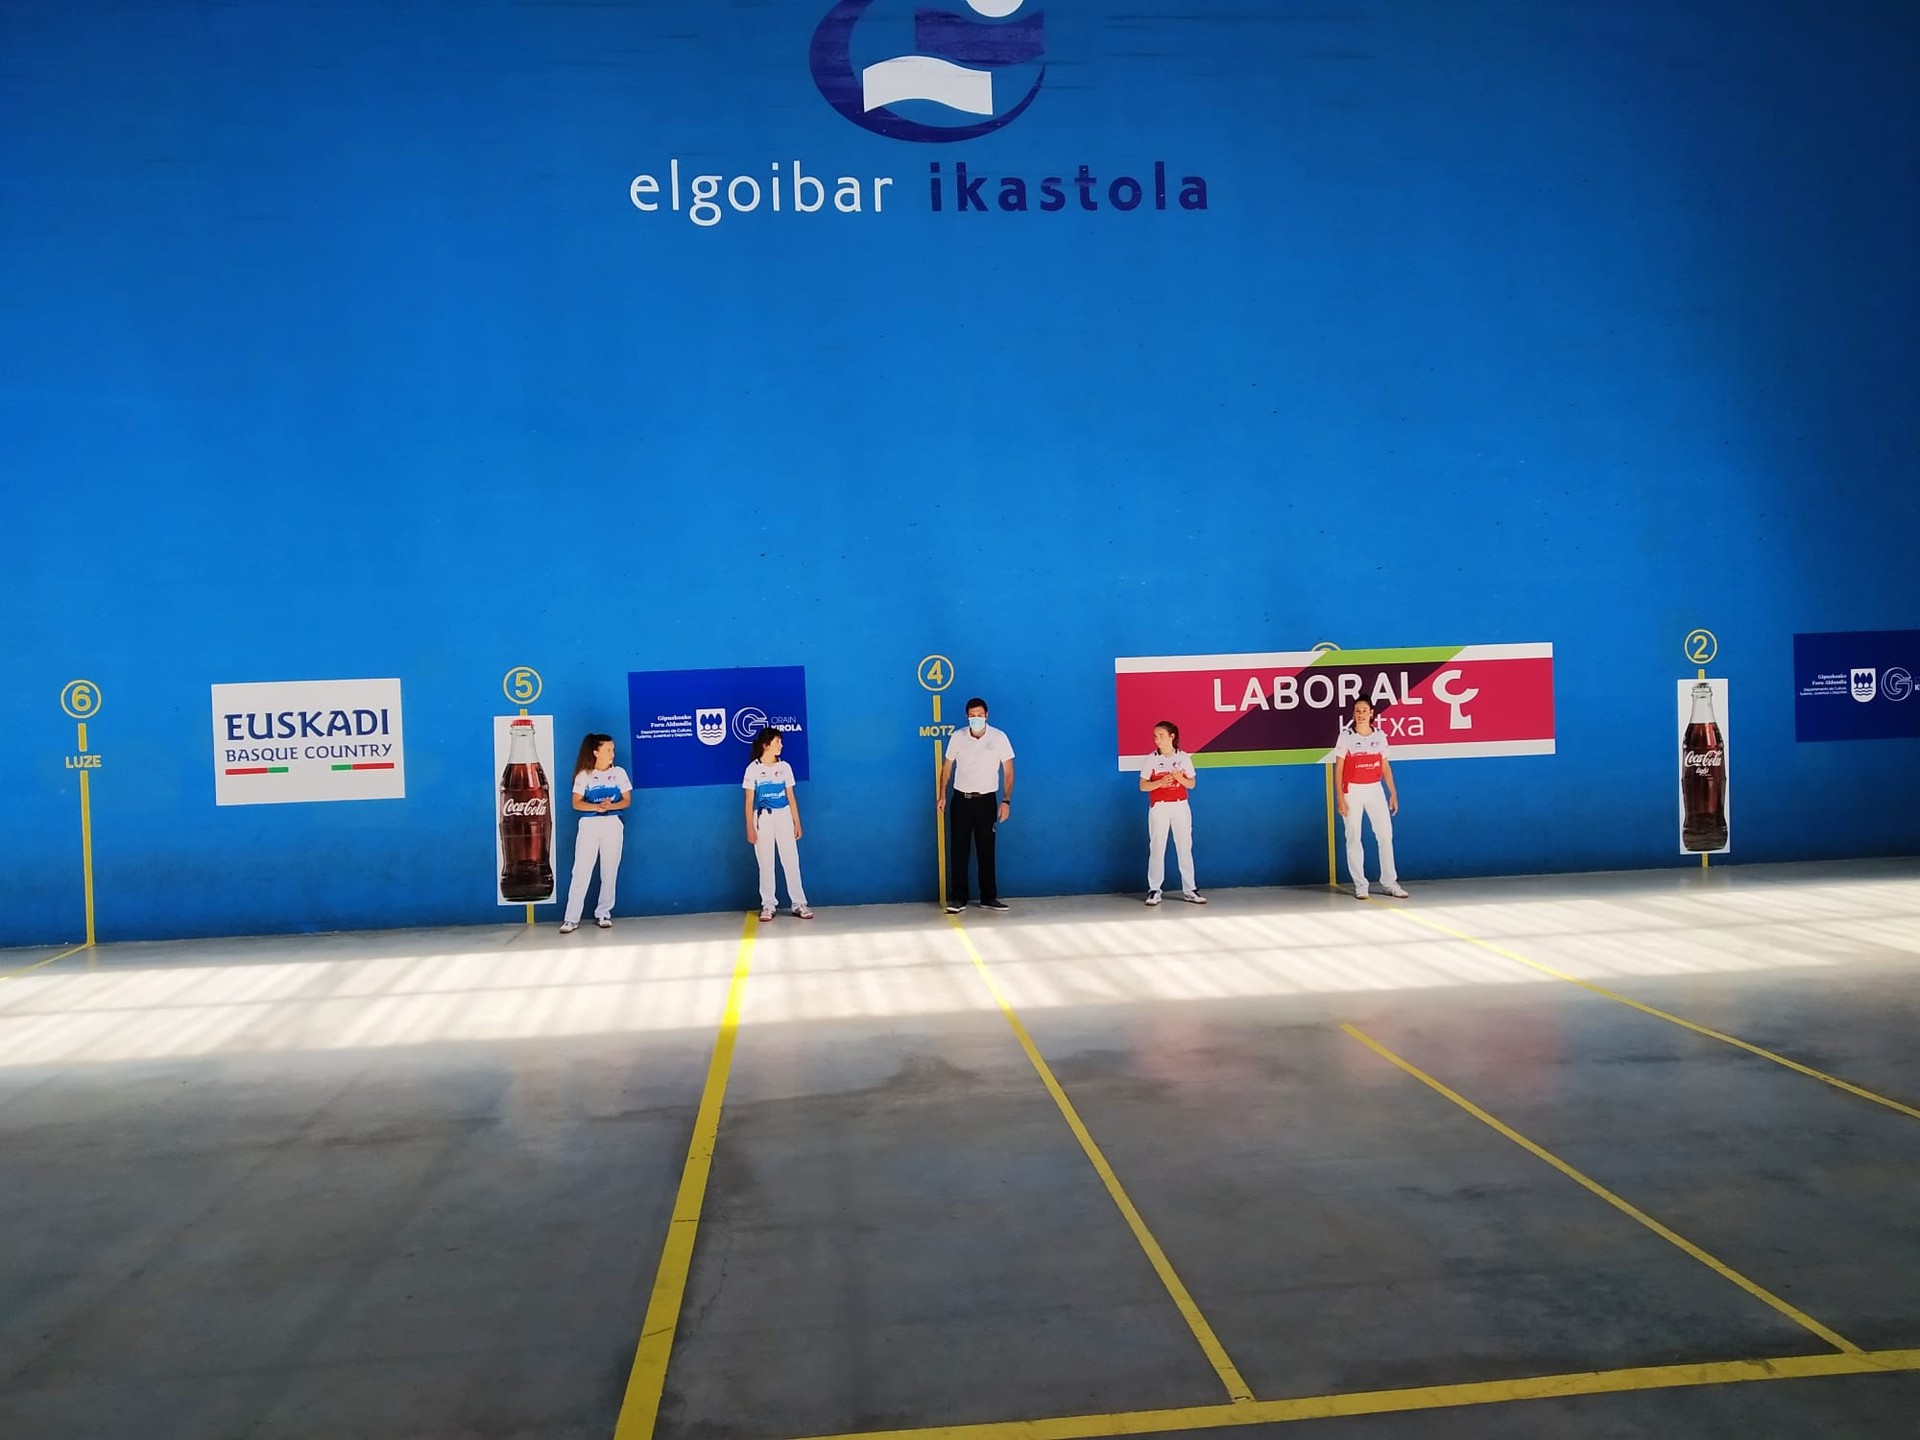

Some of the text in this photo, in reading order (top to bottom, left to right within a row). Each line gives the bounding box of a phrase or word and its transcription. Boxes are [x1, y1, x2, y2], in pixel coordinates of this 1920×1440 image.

[629, 159, 1209, 227] elgoibar ikastola
[1692, 634, 1709, 660] 2
[515, 672, 533, 698] 5
[926, 659, 944, 685] 4
[71, 685, 91, 712] 6
[1212, 671, 1424, 712] LABORAL
[223, 708, 390, 741] EUSKADI
[770, 716, 797, 724] ORAIN
[919, 725, 956, 737] MOTZ
[1338, 712, 1425, 738] ktxa
[65, 754, 103, 768] LUZE
[225, 743, 393, 763] BASQUE COUNTRY
